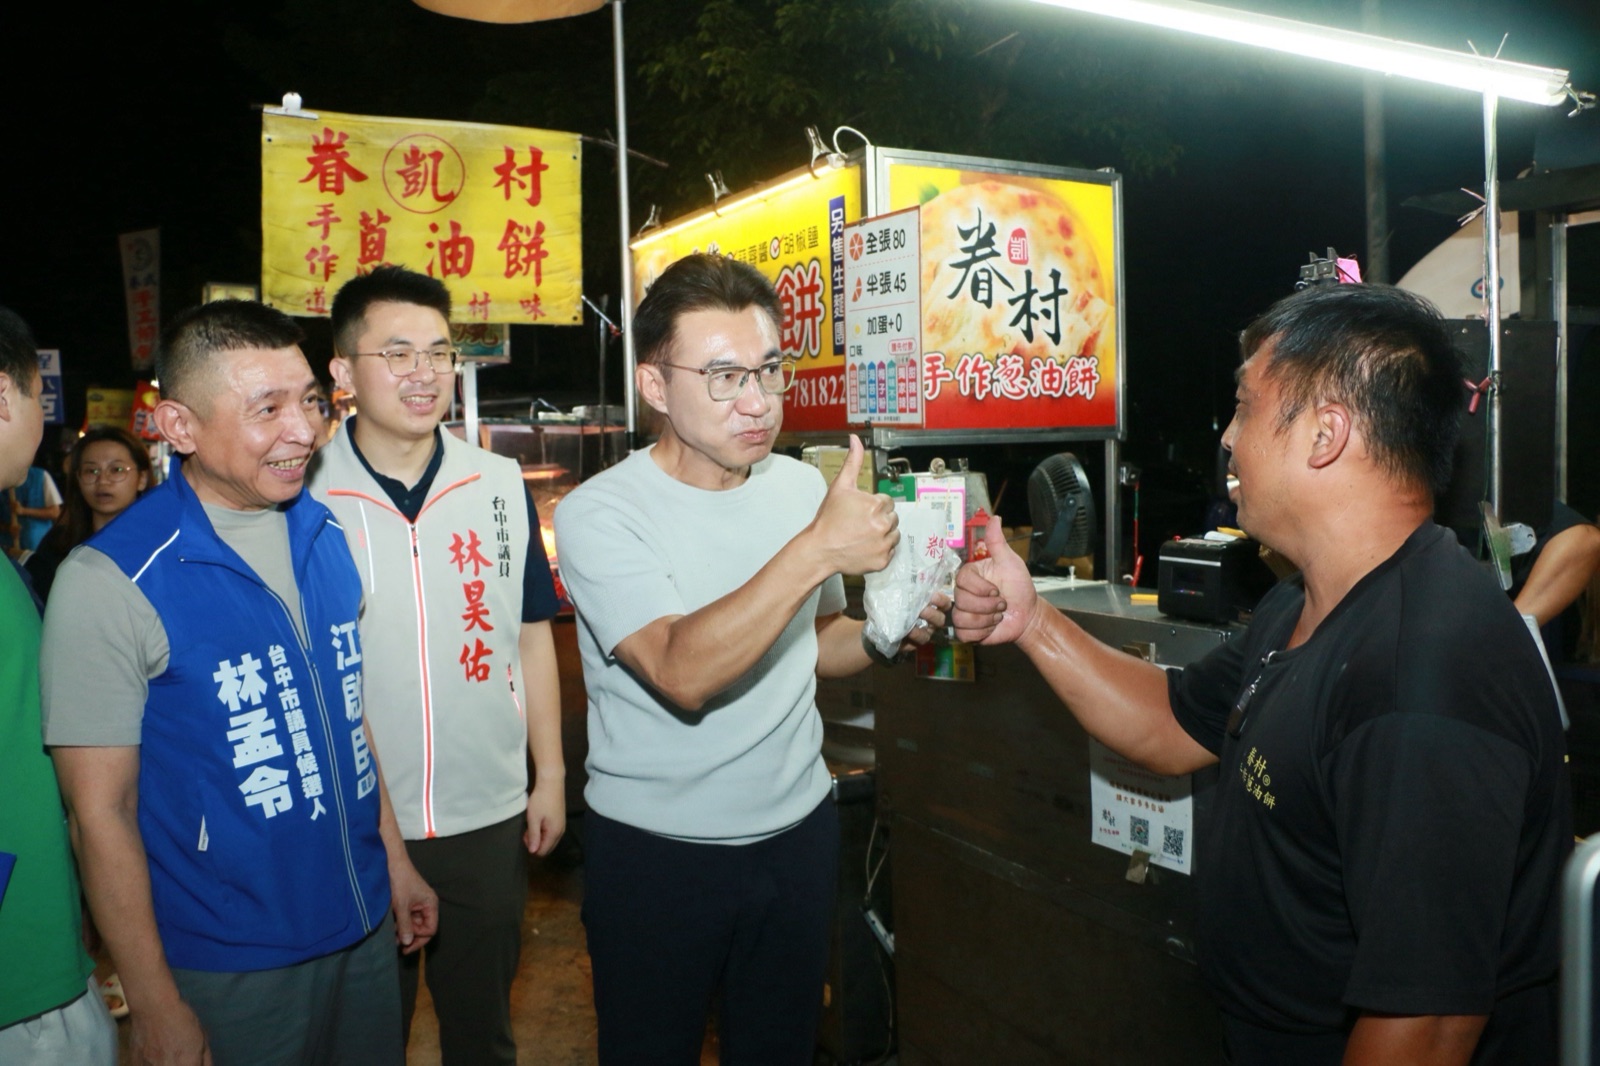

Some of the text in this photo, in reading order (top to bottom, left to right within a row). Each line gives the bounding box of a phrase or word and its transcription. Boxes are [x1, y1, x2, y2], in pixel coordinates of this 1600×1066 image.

[448, 528, 495, 683] 林昊佑
[212, 652, 294, 820] 林孟令
[268, 644, 327, 821] 台中市議員候選人
